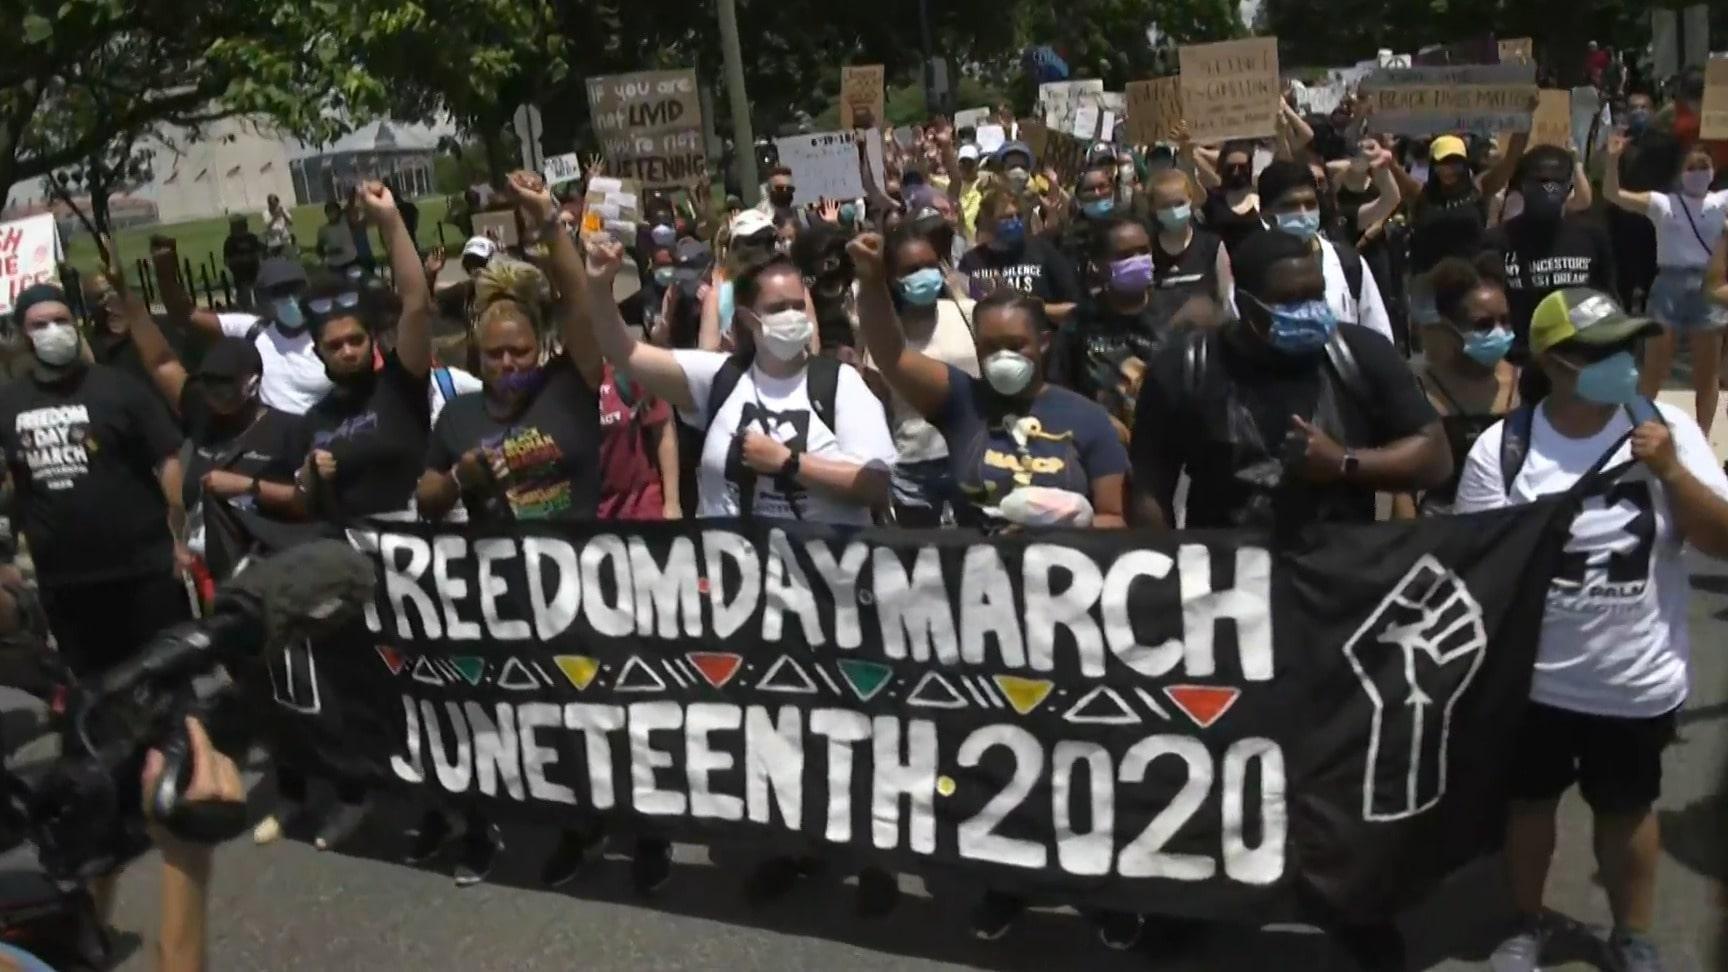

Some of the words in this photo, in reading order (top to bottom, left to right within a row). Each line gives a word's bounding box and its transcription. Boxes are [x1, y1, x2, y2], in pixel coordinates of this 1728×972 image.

[614, 81, 649, 101] you
[657, 78, 691, 94] are
[33, 425, 69, 448] DAY
[26, 444, 88, 470] MARCH
[872, 543, 1275, 681] MARCH
[390, 694, 939, 856] JUNETEENTH
[957, 723, 1288, 885] 2020
